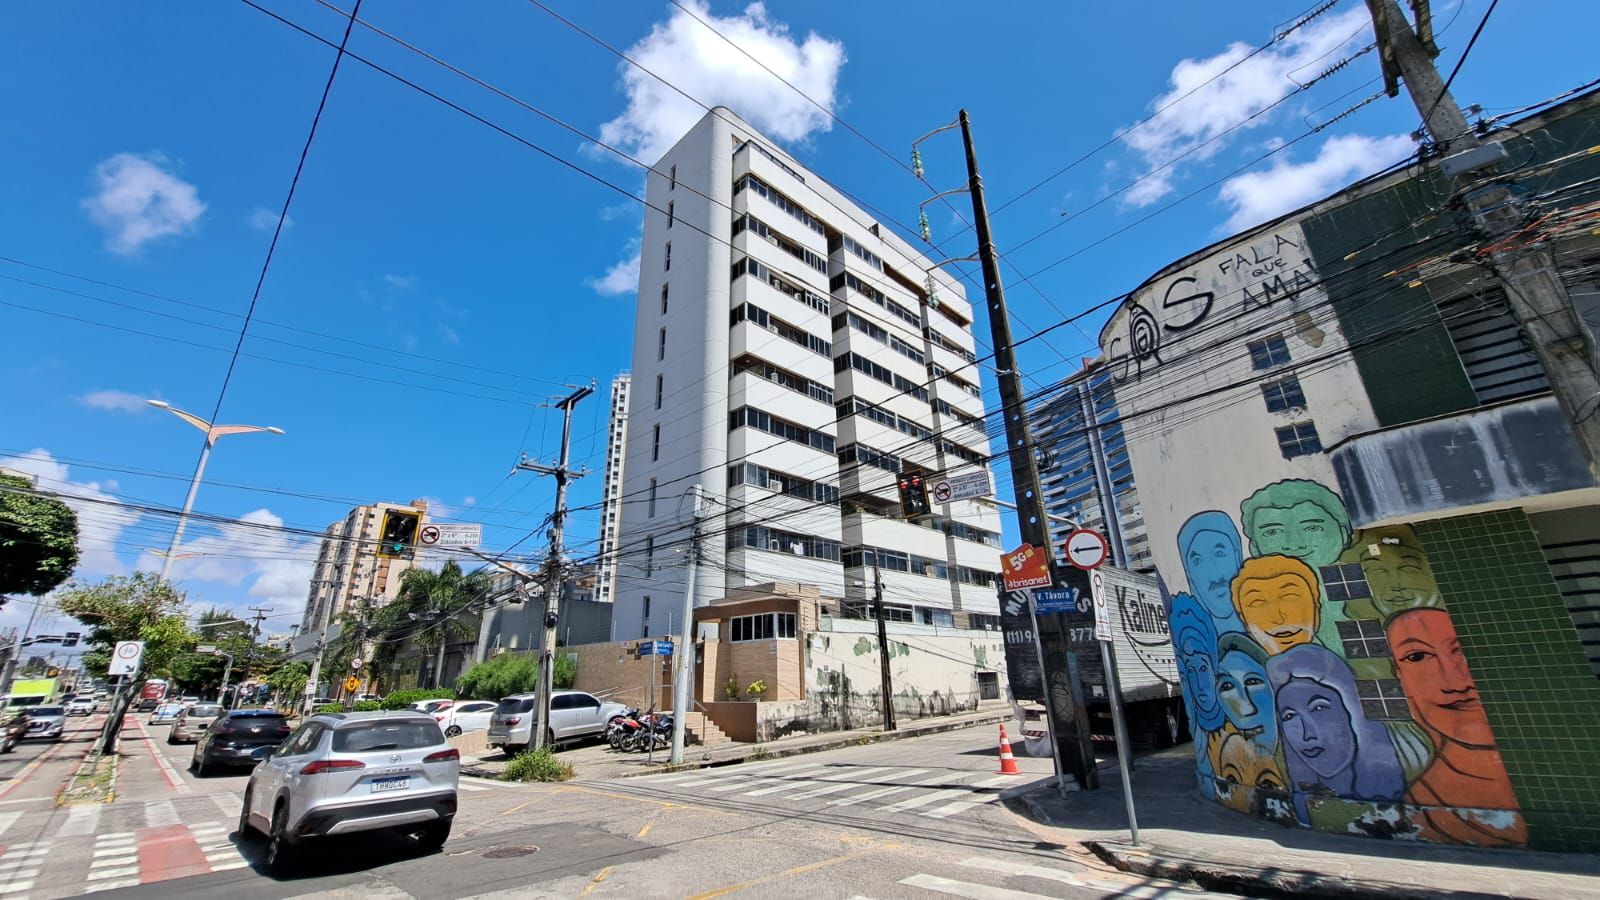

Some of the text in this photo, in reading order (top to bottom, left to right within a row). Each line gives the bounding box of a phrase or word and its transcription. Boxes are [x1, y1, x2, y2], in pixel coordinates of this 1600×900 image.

[1218, 234, 1298, 275] FALA
[1251, 259, 1287, 277] QUE
[1010, 552, 1027, 571] 5G
[1013, 575, 1048, 588] brisanet
